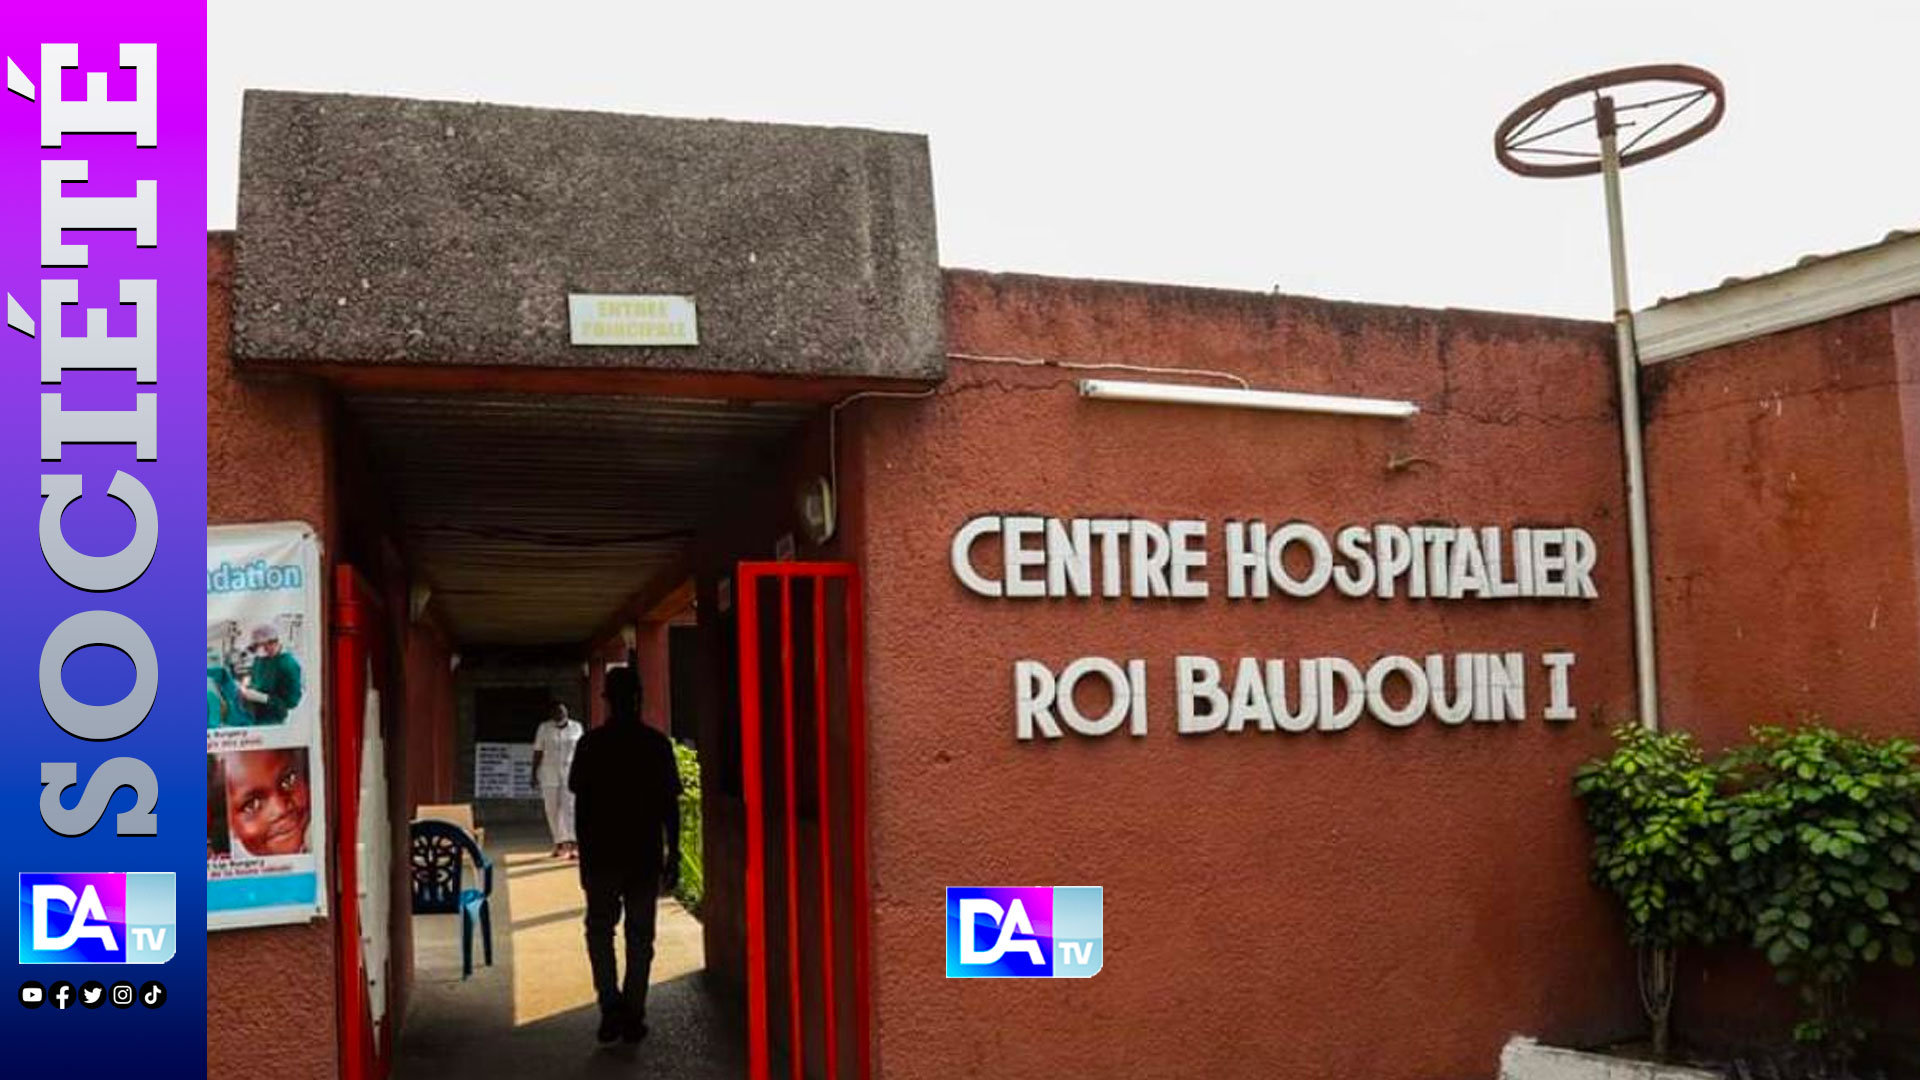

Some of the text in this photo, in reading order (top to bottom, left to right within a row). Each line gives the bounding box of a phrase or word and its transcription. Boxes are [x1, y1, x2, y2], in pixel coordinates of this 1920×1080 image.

[952, 515, 1598, 599] CENTRE HOSPITALIER
[1014, 653, 1577, 740] ROI BAUDOUIN I
